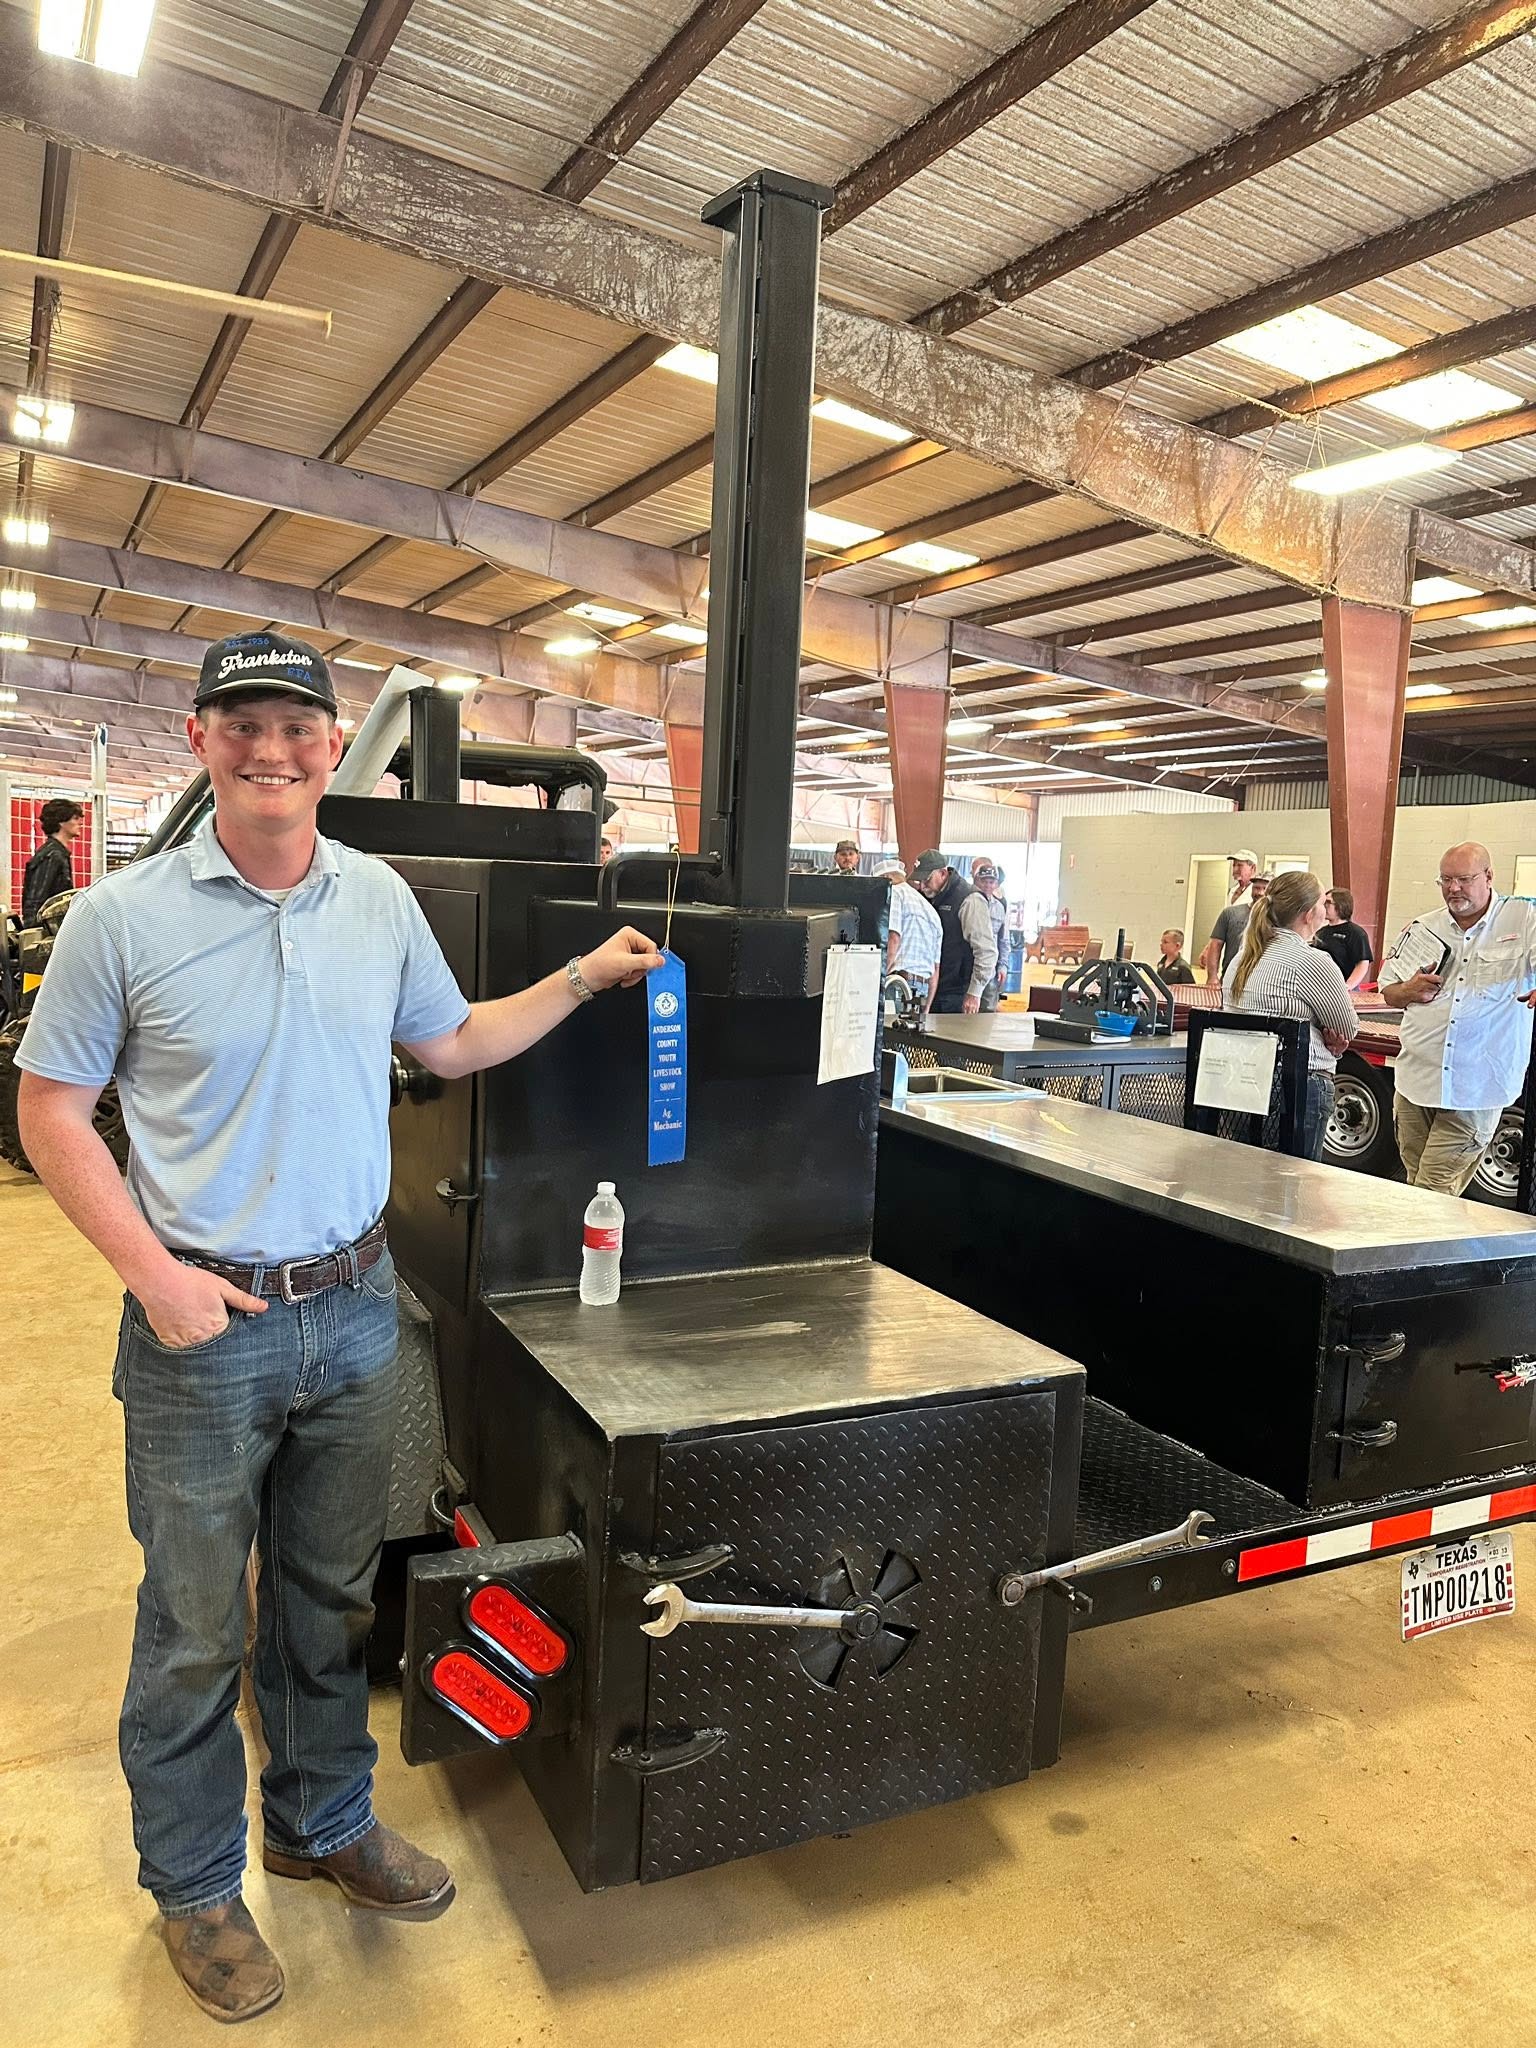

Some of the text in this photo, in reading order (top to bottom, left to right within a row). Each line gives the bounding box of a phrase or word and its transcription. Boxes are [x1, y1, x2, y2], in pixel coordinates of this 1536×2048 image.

[217, 648, 313, 679] Frankston
[287, 667, 313, 683] FFA
[653, 1024, 681, 1034] ANDERSON
[657, 1039, 678, 1048] COUNTY
[658, 1053, 677, 1063] YOUTH
[653, 1067, 682, 1077] LIVESTOCK
[660, 1082, 676, 1091] SHOW
[653, 1119, 682, 1131] Mechanic
[1436, 1545, 1478, 1568] TEXAS
[1426, 1559, 1486, 1578] TEMPORARY REGISTRATION
[1411, 1564, 1506, 1624] TMP00218
[1430, 1608, 1484, 1628] LIMITED USE PLATE
